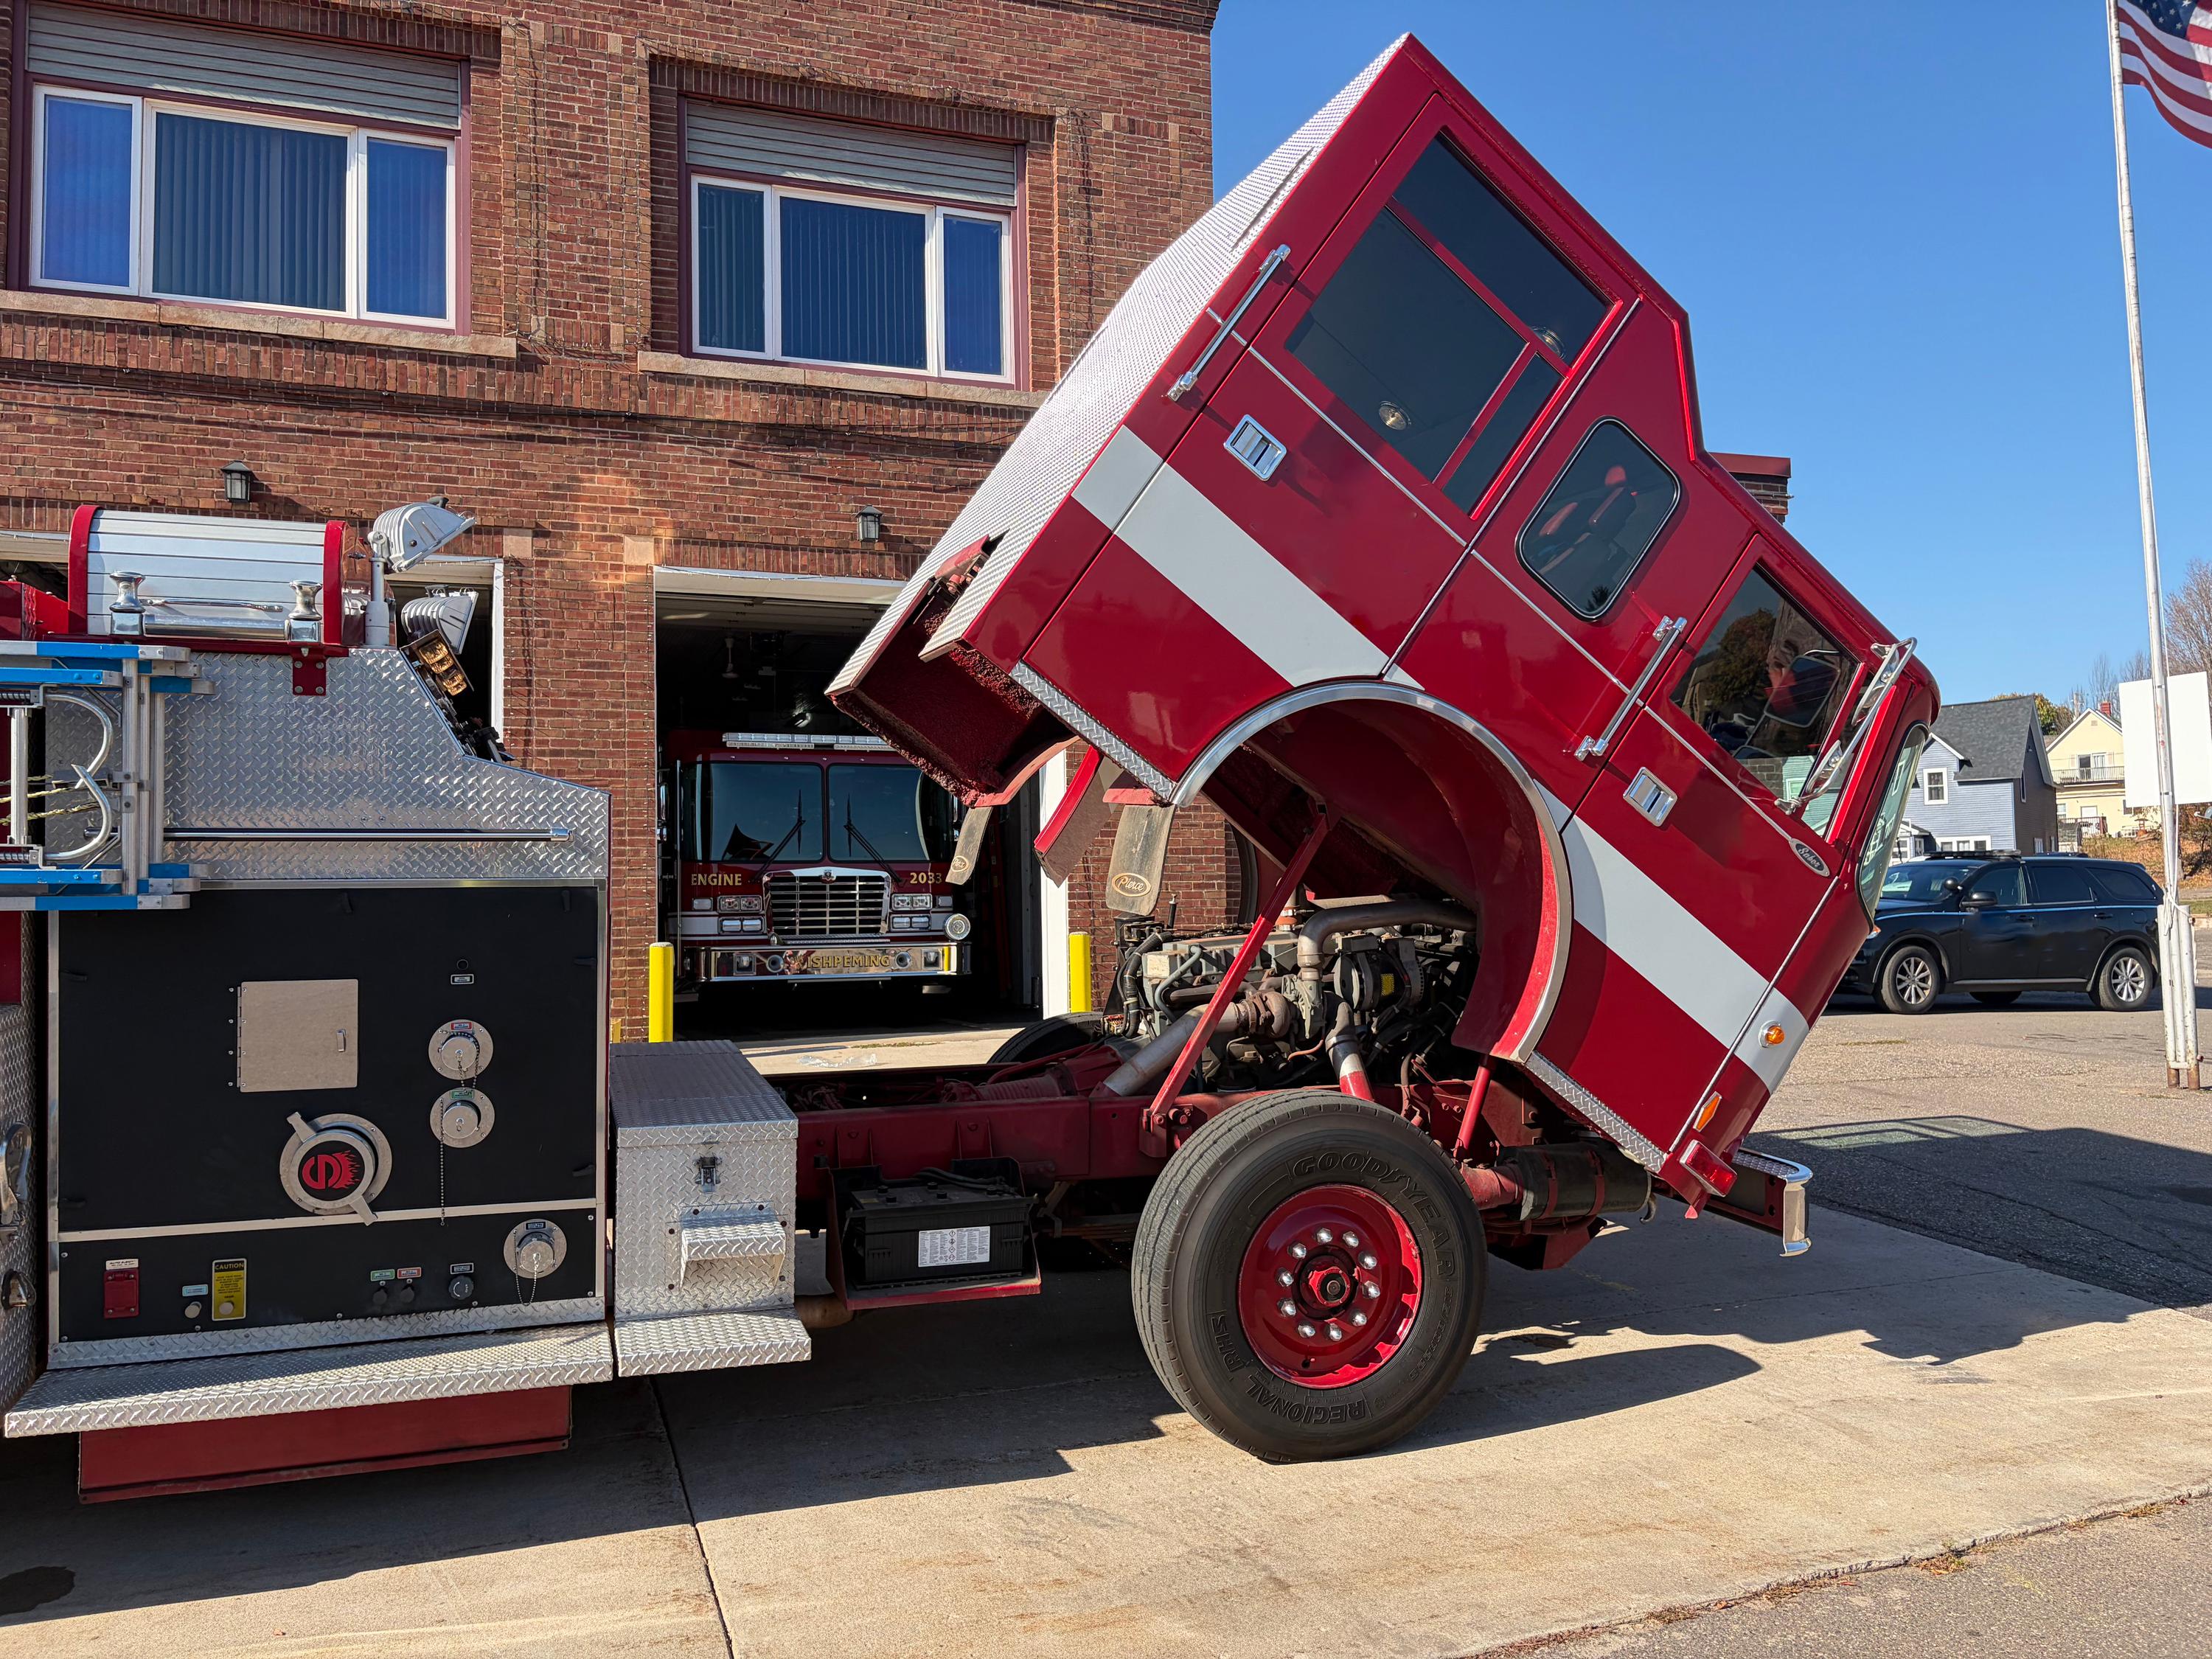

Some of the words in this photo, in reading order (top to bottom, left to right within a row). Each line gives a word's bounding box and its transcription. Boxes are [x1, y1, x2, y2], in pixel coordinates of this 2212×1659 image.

[1798, 847, 1820, 868] Saber
[691, 873, 742, 886] ENGINE
[910, 872, 942, 884] 2033
[1117, 876, 1144, 891] Pierce
[807, 955, 891, 968] ISHPEMING
[1293, 1151, 1455, 1276] GOODYEAR
[215, 1262, 244, 1270] CAUTION
[1211, 1313, 1245, 1372] RHS
[1245, 1374, 1366, 1425] REGIONAL
